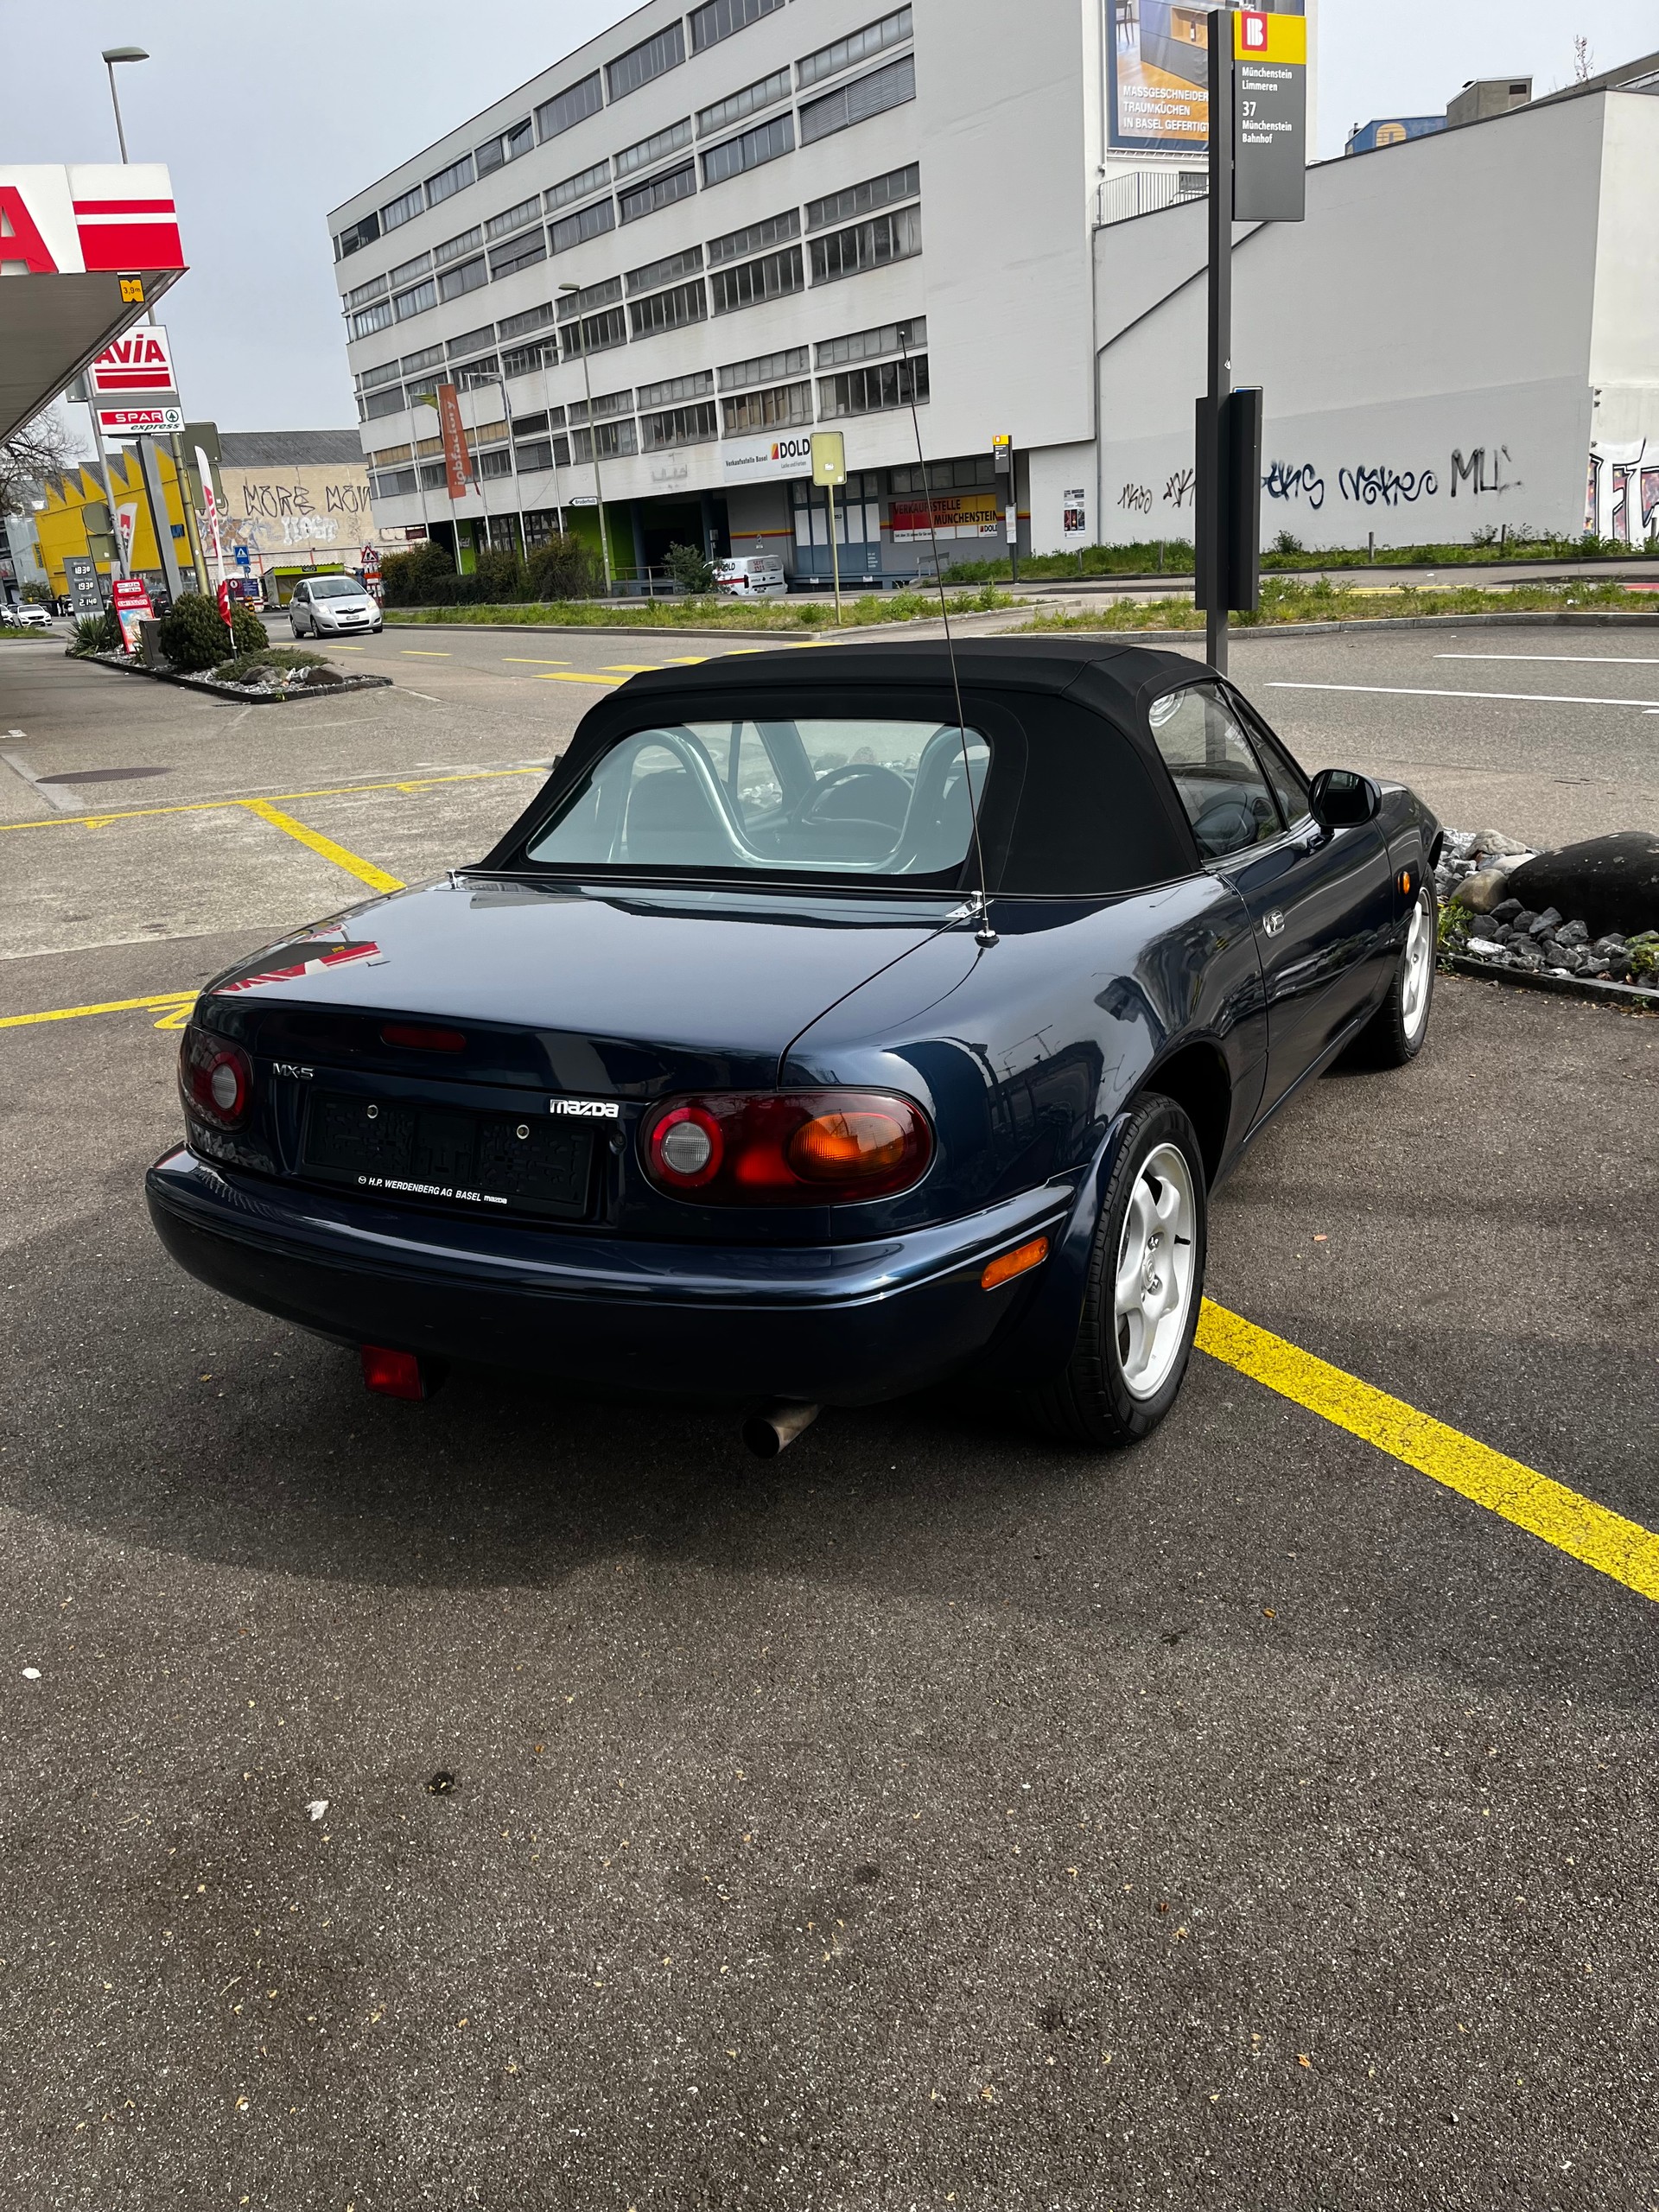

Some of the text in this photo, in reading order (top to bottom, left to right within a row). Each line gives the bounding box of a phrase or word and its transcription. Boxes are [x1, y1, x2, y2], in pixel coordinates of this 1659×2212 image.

[1242, 67, 1293, 79] Münchenstein
[1242, 79, 1278, 92] Limmeren
[1123, 100, 1192, 117] TRAUMKÜCHEN
[1242, 100, 1257, 117] 37
[1123, 118, 1134, 129] IN
[1135, 118, 1164, 130] BASEL
[1242, 120, 1293, 132] Münchenstein
[1242, 133, 1273, 144] Bahnhof
[115, 412, 163, 424] SPAR
[130, 423, 181, 432] express
[779, 438, 810, 459] DOLD
[725, 454, 768, 467] Verkaufsstelle Basel
[272, 1062, 315, 1080] MX-5
[368, 1177, 384, 1188] H.P.
[385, 1179, 441, 1196] WERDENBERG
[441, 1188, 454, 1198] AG
[455, 1190, 481, 1202] BASEL
